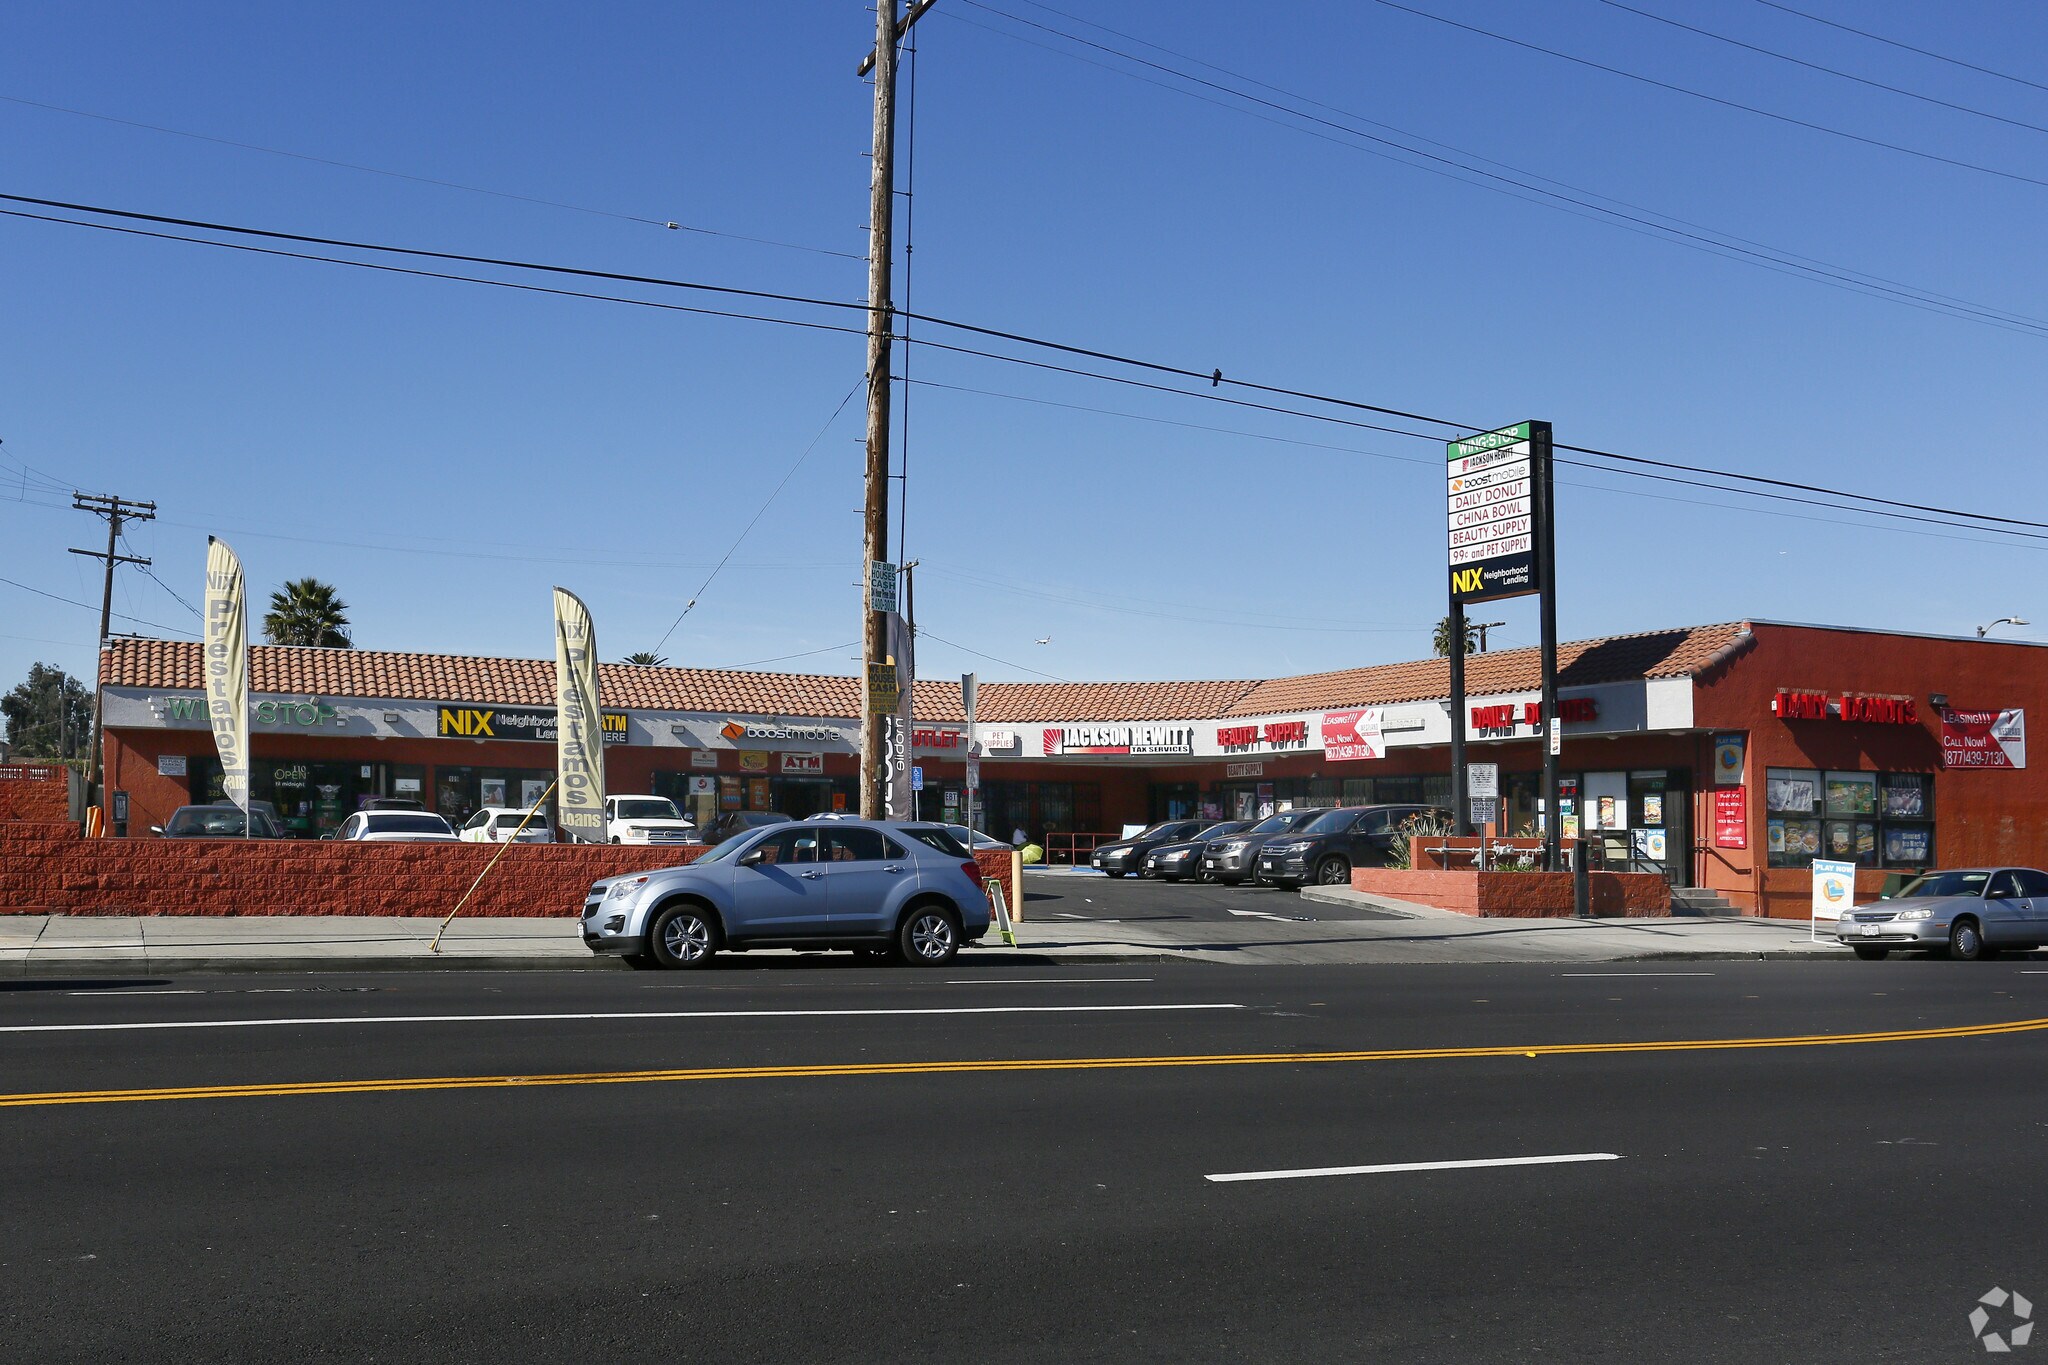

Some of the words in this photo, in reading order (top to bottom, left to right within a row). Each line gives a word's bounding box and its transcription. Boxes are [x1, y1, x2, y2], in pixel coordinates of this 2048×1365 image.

[1469, 452, 1494, 468] JACKSON
[1455, 492, 1482, 509] DAILY
[1485, 482, 1524, 502] DONUT
[1456, 509, 1489, 526] CHINA
[1492, 501, 1523, 517] BOWL
[1453, 526, 1489, 545] BEAUTY
[1492, 518, 1528, 537] SUPPLY
[1471, 546, 1485, 559] and
[1486, 543, 1500, 556] PET
[1500, 536, 1528, 553] SUPPLY
[872, 560, 881, 570] WE
[882, 563, 896, 572] BUY
[207, 571, 236, 591] Nix
[871, 579, 896, 590] CA$H
[872, 570, 896, 582] HOUSES
[1452, 567, 1484, 594] NIX
[1484, 564, 1529, 580] Neighborhood
[1502, 574, 1529, 586] Lending
[556, 620, 585, 639] Nix
[257, 702, 336, 726] STOP
[1471, 704, 1515, 729] DAILY
[1776, 692, 1830, 720] DAILY
[1840, 695, 1919, 725] DONUTS
[441, 709, 495, 736] NIX
[1064, 728, 1130, 746] JACKSON
[1132, 726, 1190, 746] HEWITT
[1217, 726, 1258, 746] BEAUTY
[1264, 721, 1306, 742] SUPPLY
[1944, 736, 1963, 747] CALL
[1964, 736, 1986, 748] NOW!
[984, 740, 1014, 748] SUPPLIES
[1326, 744, 1370, 759] (877)439-7130
[784, 756, 820, 768] ATM
[1944, 749, 2005, 766] (877)439-7130
[274, 768, 307, 780] OPEN
[1228, 764, 1244, 776] BEAUTY
[1245, 762, 1262, 776] SUPPLY
[946, 792, 957, 800] EBT
[560, 808, 602, 829] Loans
[1816, 864, 1834, 872] PLAY
